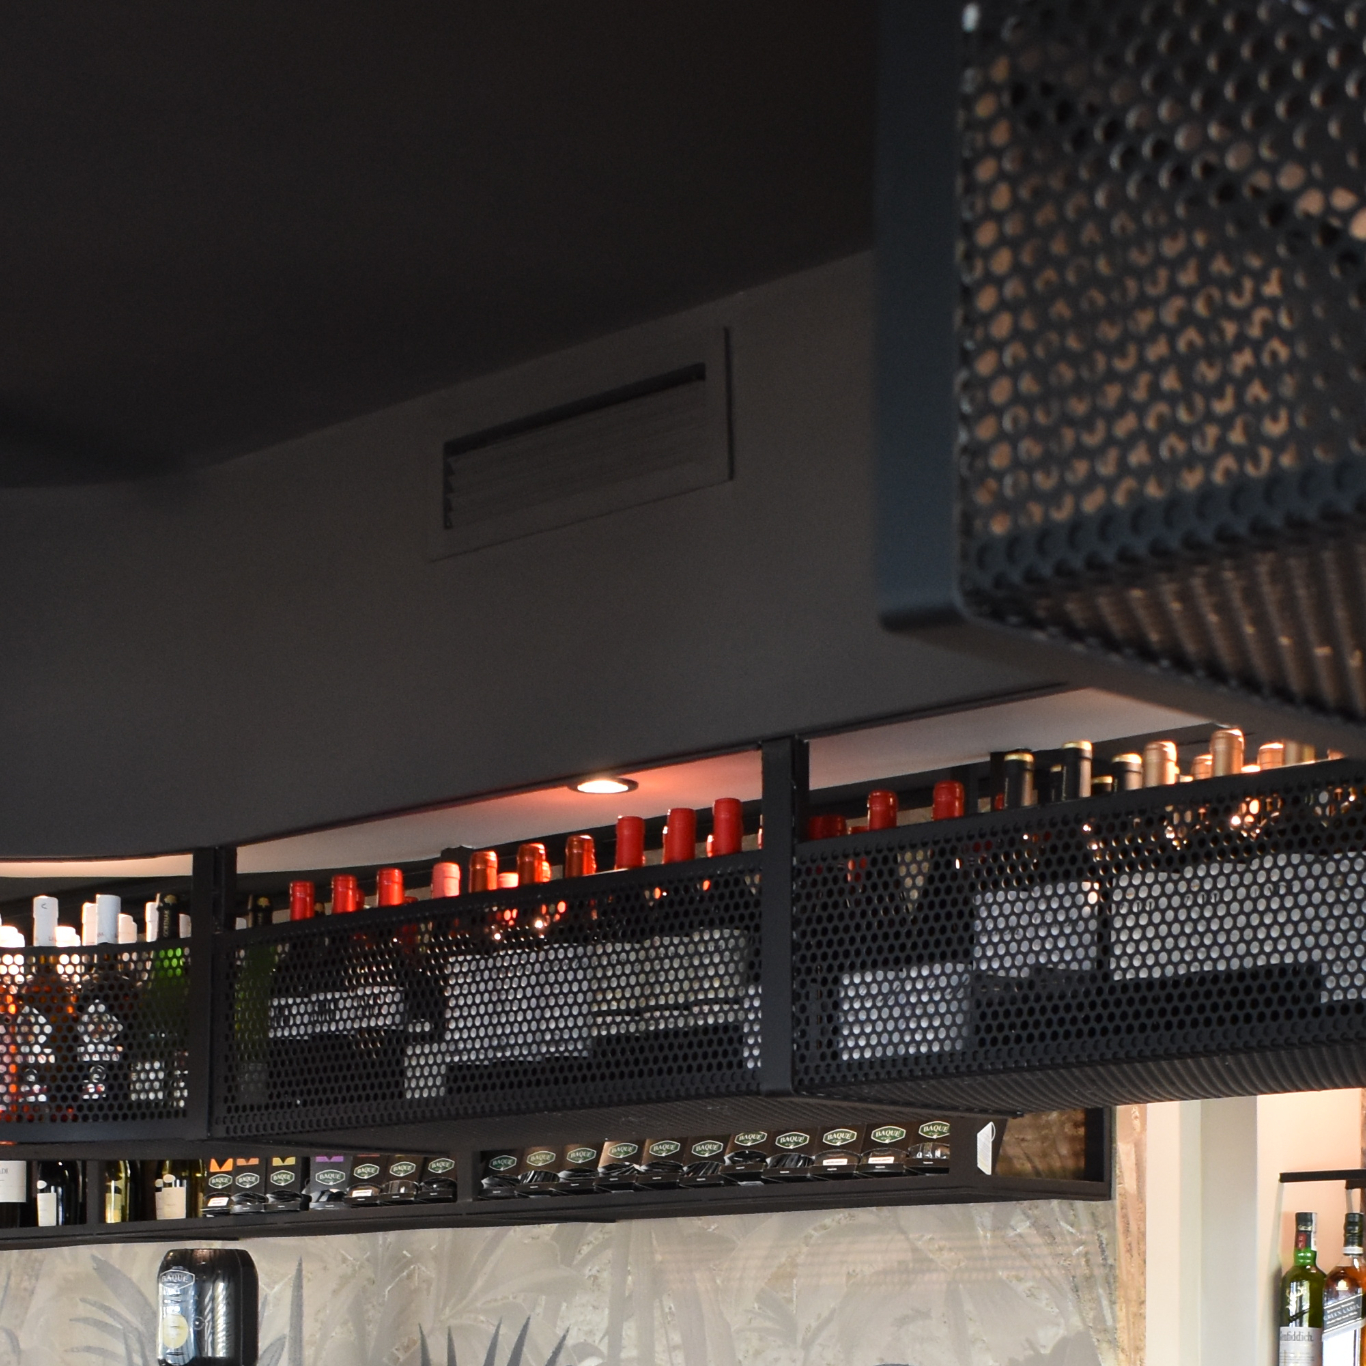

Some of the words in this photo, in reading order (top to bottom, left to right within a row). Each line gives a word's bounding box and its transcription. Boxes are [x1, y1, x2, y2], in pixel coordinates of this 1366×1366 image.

[738, 1132, 764, 1141] BAQUE
[826, 1132, 854, 1141] BAQUE
[874, 1129, 903, 1138] BAQUE
[779, 1135, 807, 1144] BAQUE
[652, 1143, 677, 1152] BAQUE
[695, 1143, 720, 1152] BAQUE
